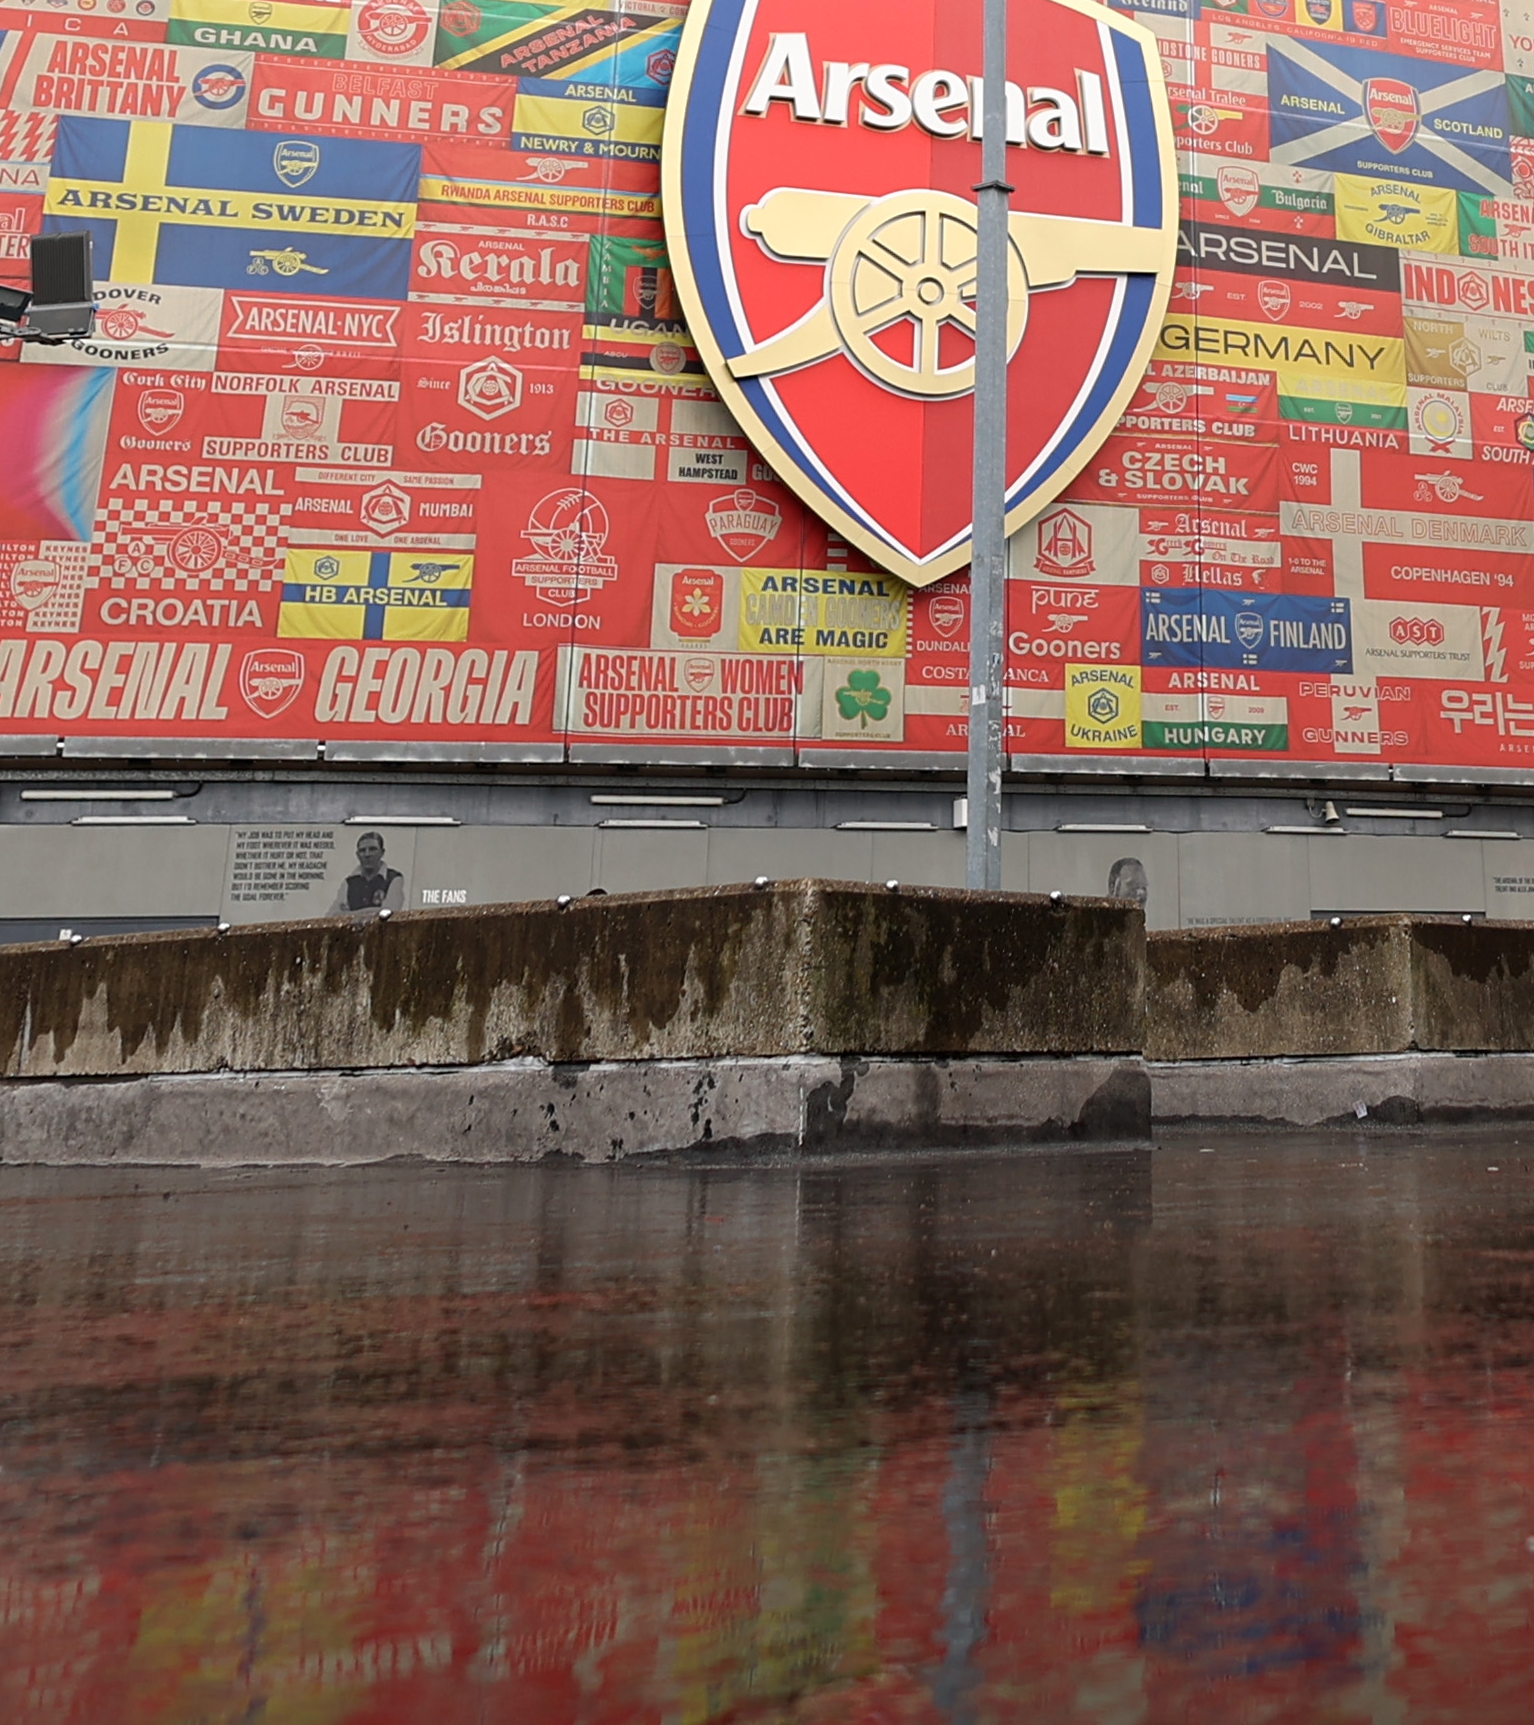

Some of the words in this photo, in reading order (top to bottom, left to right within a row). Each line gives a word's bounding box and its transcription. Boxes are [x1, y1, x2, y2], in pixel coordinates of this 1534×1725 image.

[1390, 6, 1496, 49] BLUELIGHT
[193, 26, 318, 53] GHANA
[33, 74, 187, 120] BRITTANY
[739, 32, 1110, 157] Arsenal
[1280, 93, 1345, 115] ARSENAL
[1433, 118, 1503, 139] SCOTLAND
[59, 186, 239, 218] ARSENAL
[251, 202, 406, 230] SWEDEN
[440, 183, 490, 201] RWANDA
[493, 187, 545, 204] ARSENAL
[548, 192, 622, 210] SUPPORTERS
[625, 197, 655, 213] CLUB
[1159, 325, 1386, 370] GERMANY
[213, 376, 299, 394] NORFOLK
[312, 379, 395, 399] ARSENAL
[417, 377, 451, 390] Since
[529, 383, 554, 394] 1913
[590, 429, 629, 443] THE
[641, 433, 735, 448] ARSENAL
[1288, 426, 1399, 450] LITHUANIA
[207, 441, 329, 460] SUPPORTERS
[341, 445, 389, 464] CLUB
[695, 454, 724, 465] WEST
[1121, 452, 1226, 475] CZECH
[1482, 445, 1526, 465] SOUTH
[109, 464, 284, 496] ARSENAL
[678, 467, 738, 480] HAMPSTEAD
[295, 497, 353, 517] ARSENAL
[419, 502, 473, 517] MUMBAI
[305, 585, 337, 603] HB
[342, 587, 447, 606] ARSENAL
[761, 575, 890, 597] ARSENAL
[100, 599, 263, 627] CROATIA
[523, 613, 600, 628] LONDON
[759, 629, 804, 645] ARE
[816, 631, 888, 648] MAGIC
[1146, 613, 1230, 645] ARSENAL
[1270, 618, 1346, 650] FINLAND
[1009, 632, 1121, 659] Gooners
[579, 653, 679, 691] ARSENAL
[720, 657, 803, 694] WOMEN
[315, 646, 539, 725] GEORGIA
[585, 693, 732, 728] SUPPORTERS
[738, 697, 794, 732] CLUB
[1070, 723, 1137, 743] UKRAINE
[1164, 727, 1265, 746] HUNGARY
[422, 890, 439, 903] THE
[441, 890, 466, 903] FANS
